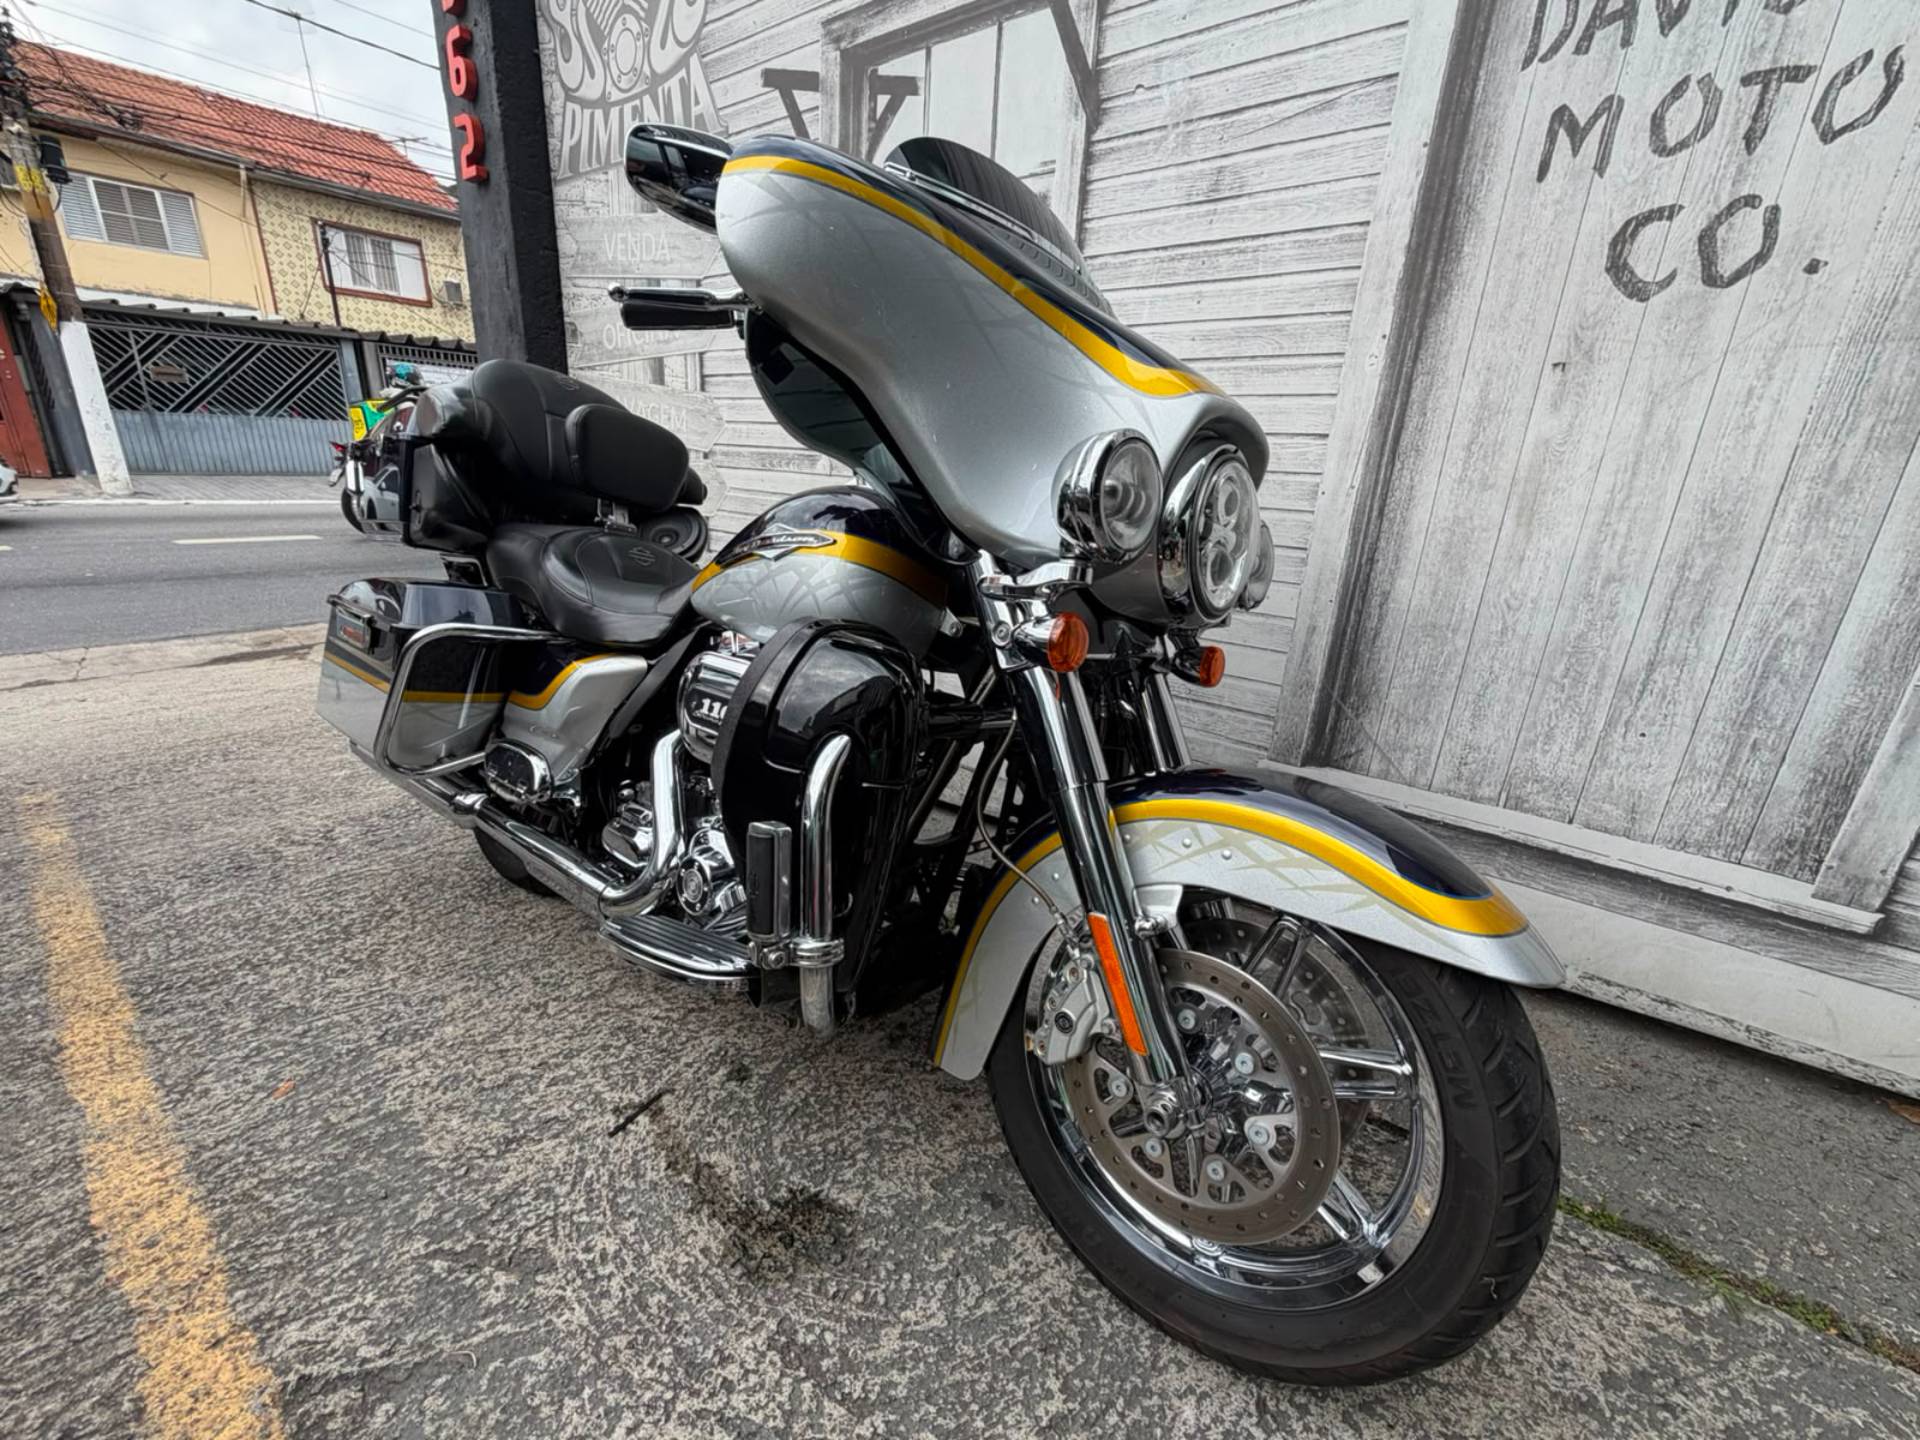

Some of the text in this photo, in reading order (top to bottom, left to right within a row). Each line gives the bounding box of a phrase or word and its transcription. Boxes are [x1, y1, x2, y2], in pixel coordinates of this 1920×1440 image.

[441, 0, 489, 182] 62
[1536, 43, 1905, 184] MOTO
[603, 230, 671, 262] VENDA
[1604, 193, 1829, 303] CO.
